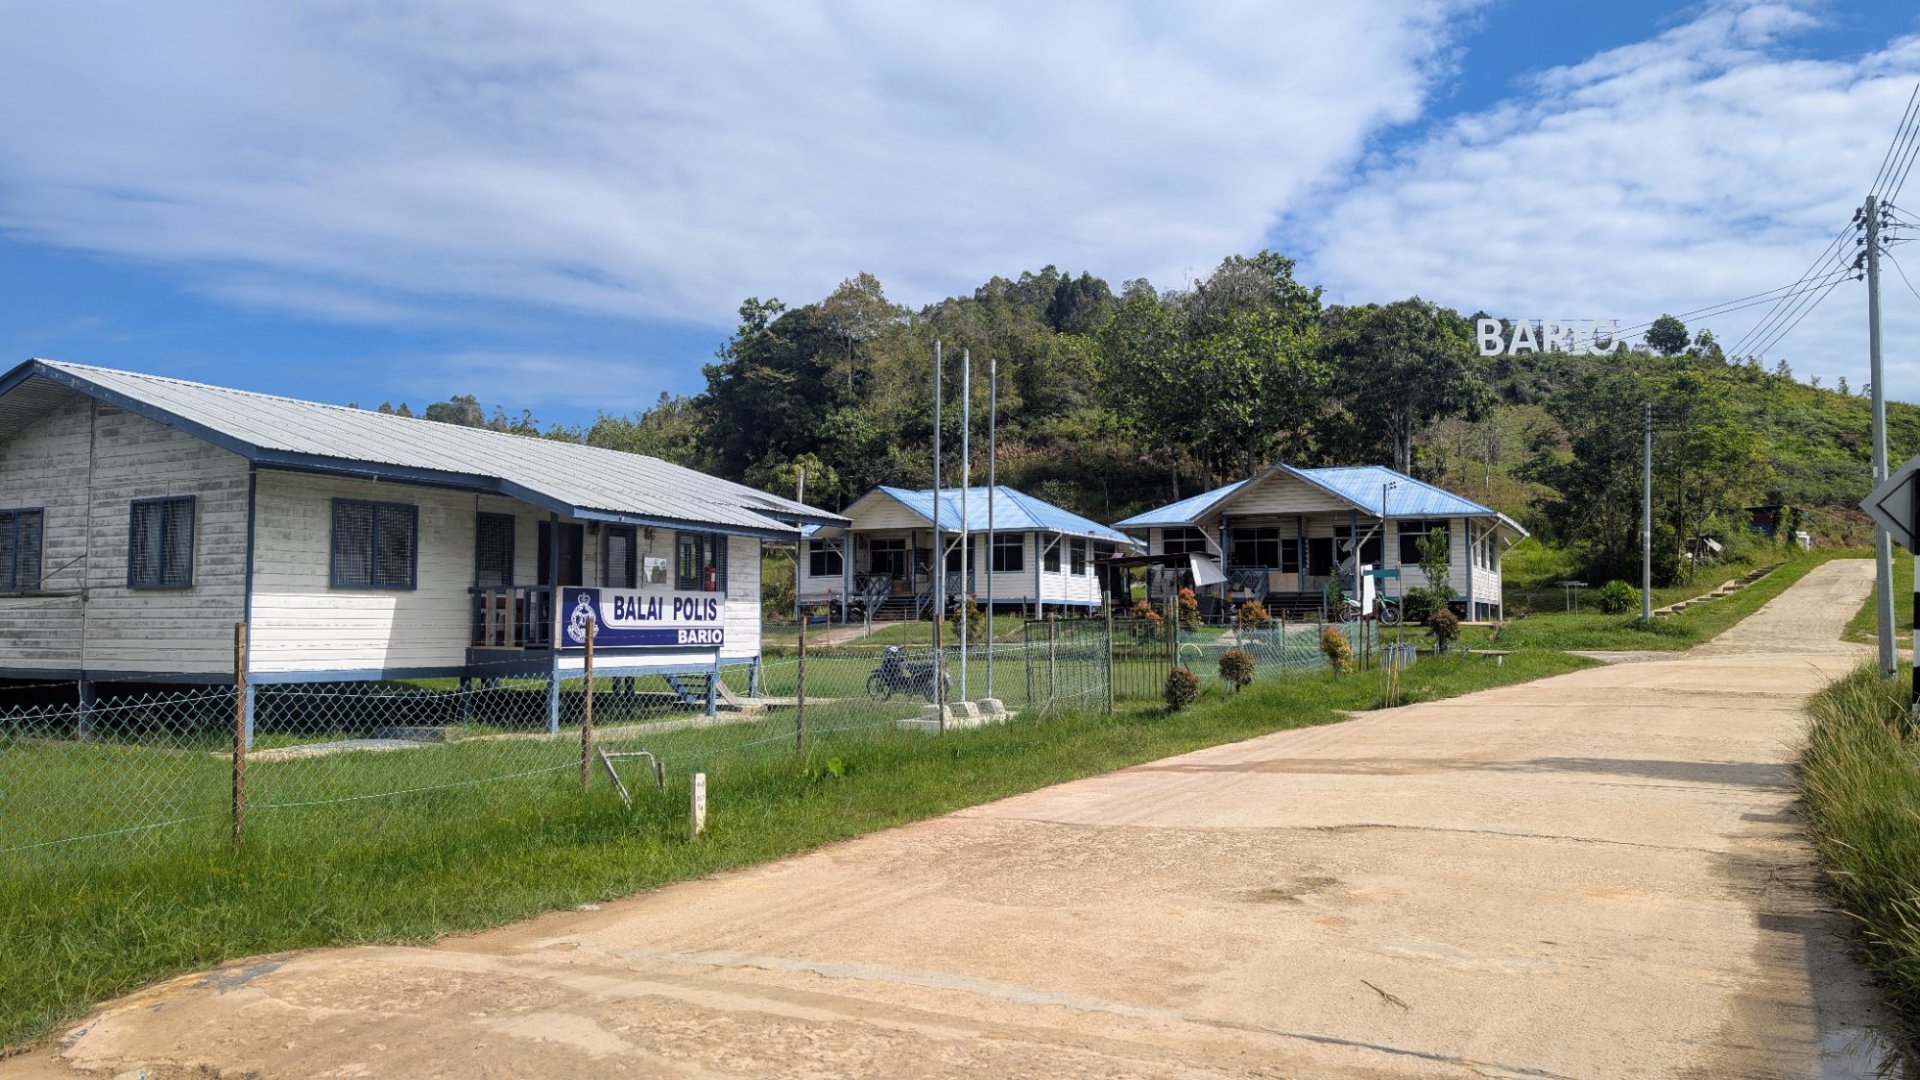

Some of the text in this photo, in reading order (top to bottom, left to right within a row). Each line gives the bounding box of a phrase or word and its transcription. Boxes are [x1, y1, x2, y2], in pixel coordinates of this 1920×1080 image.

[1477, 318, 1620, 356] BARIO
[614, 595, 717, 621] BALAI POLIS
[678, 629, 723, 644] BARIO
